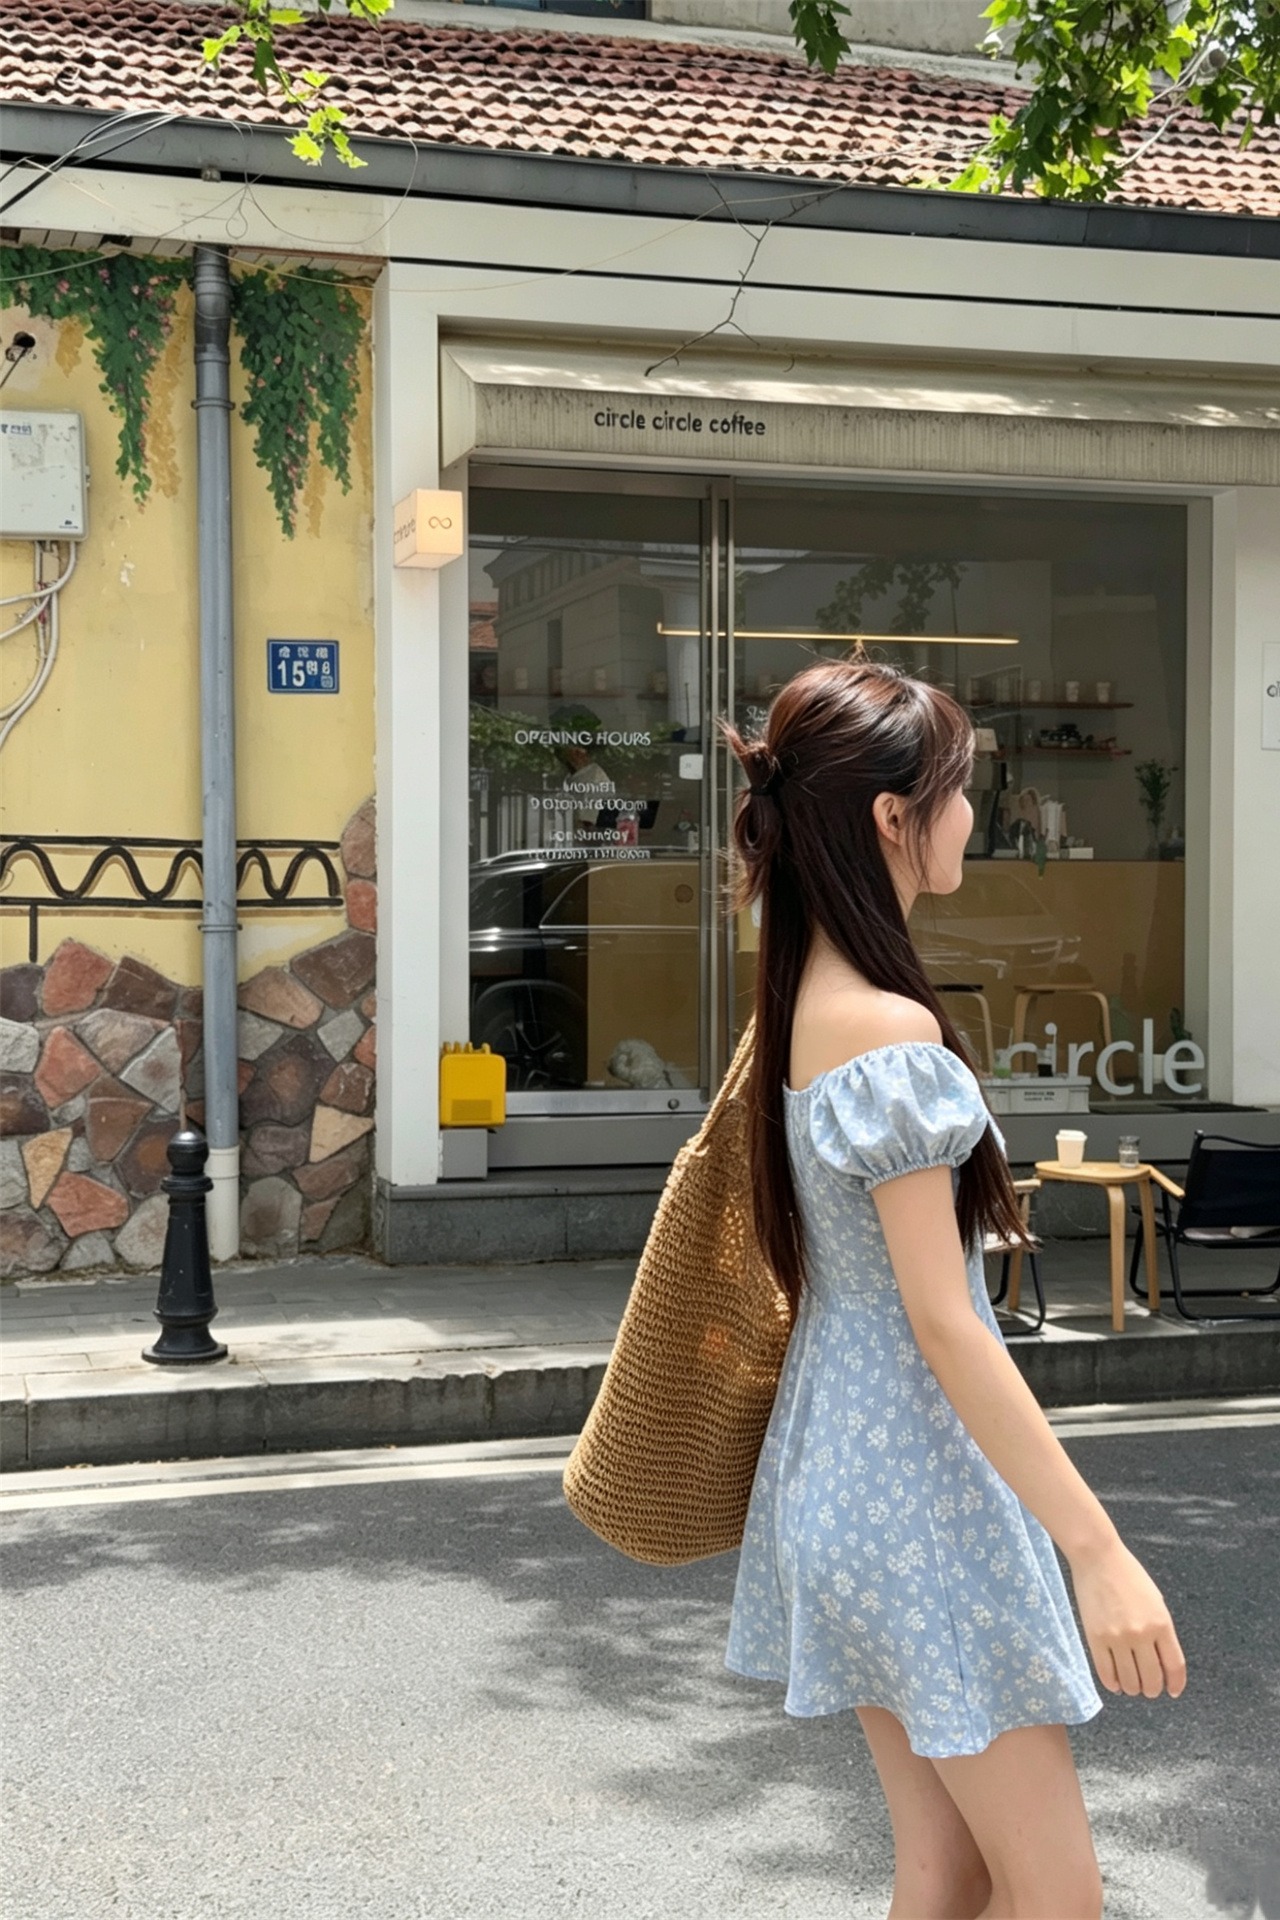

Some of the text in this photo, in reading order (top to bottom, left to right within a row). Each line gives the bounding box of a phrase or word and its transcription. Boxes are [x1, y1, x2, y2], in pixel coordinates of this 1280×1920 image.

[594, 407, 766, 435] circle circle coffee
[514, 730, 593, 746] OPENING
